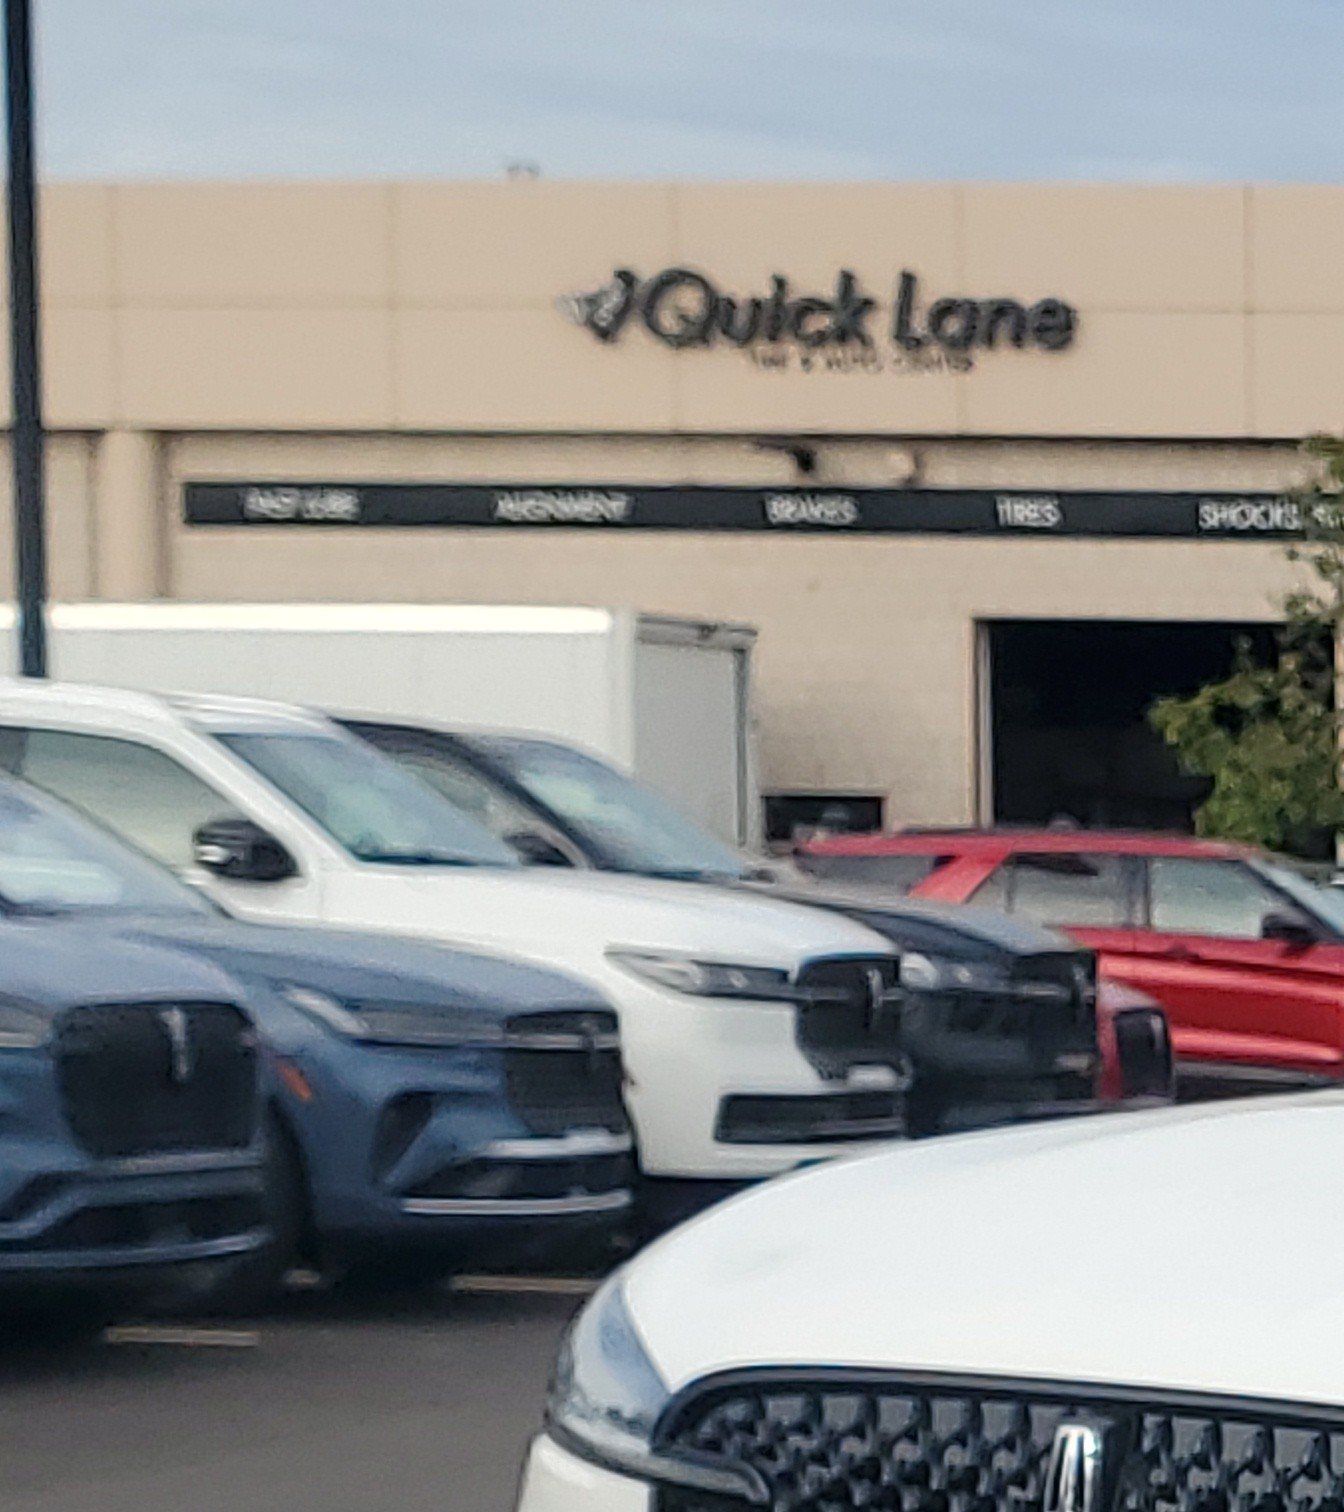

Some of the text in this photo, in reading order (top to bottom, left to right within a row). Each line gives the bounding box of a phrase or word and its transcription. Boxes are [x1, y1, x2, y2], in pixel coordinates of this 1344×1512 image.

[645, 268, 1077, 350] Quick Lane
[995, 495, 1064, 527] TIRES
